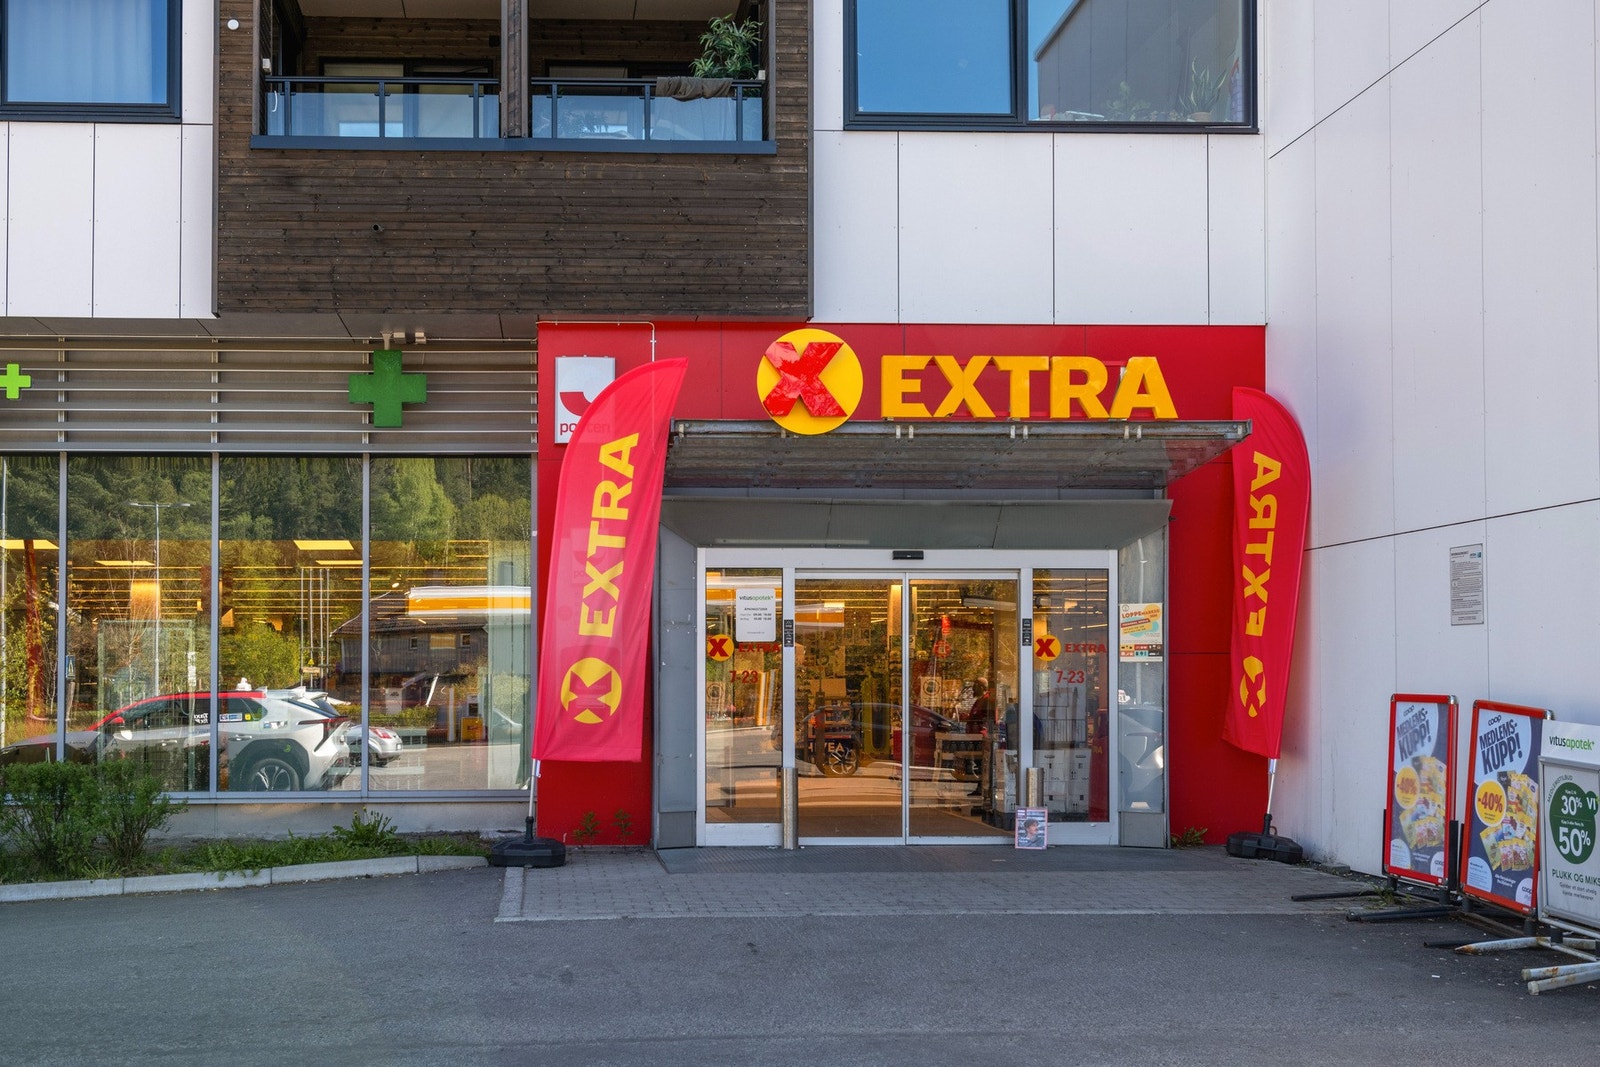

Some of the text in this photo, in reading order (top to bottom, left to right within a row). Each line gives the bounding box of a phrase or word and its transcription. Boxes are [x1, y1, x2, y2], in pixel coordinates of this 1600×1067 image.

[880, 355, 1179, 419] EXTRA
[578, 432, 640, 638] EXTRA
[738, 642, 781, 653] EXTRA
[1065, 643, 1107, 653] EXTRA
[729, 670, 759, 684] 7-23
[1055, 670, 1085, 684] 7-23
[1488, 715, 1502, 727] coop
[1398, 719, 1432, 762] KUPP!
[1481, 731, 1523, 775] KUPP!
[1478, 791, 1503, 813] -40%
[1561, 795, 1583, 816] 30%
[1559, 826, 1591, 857] 50%
[1552, 868, 1600, 886] PLUKK OG MIKS
